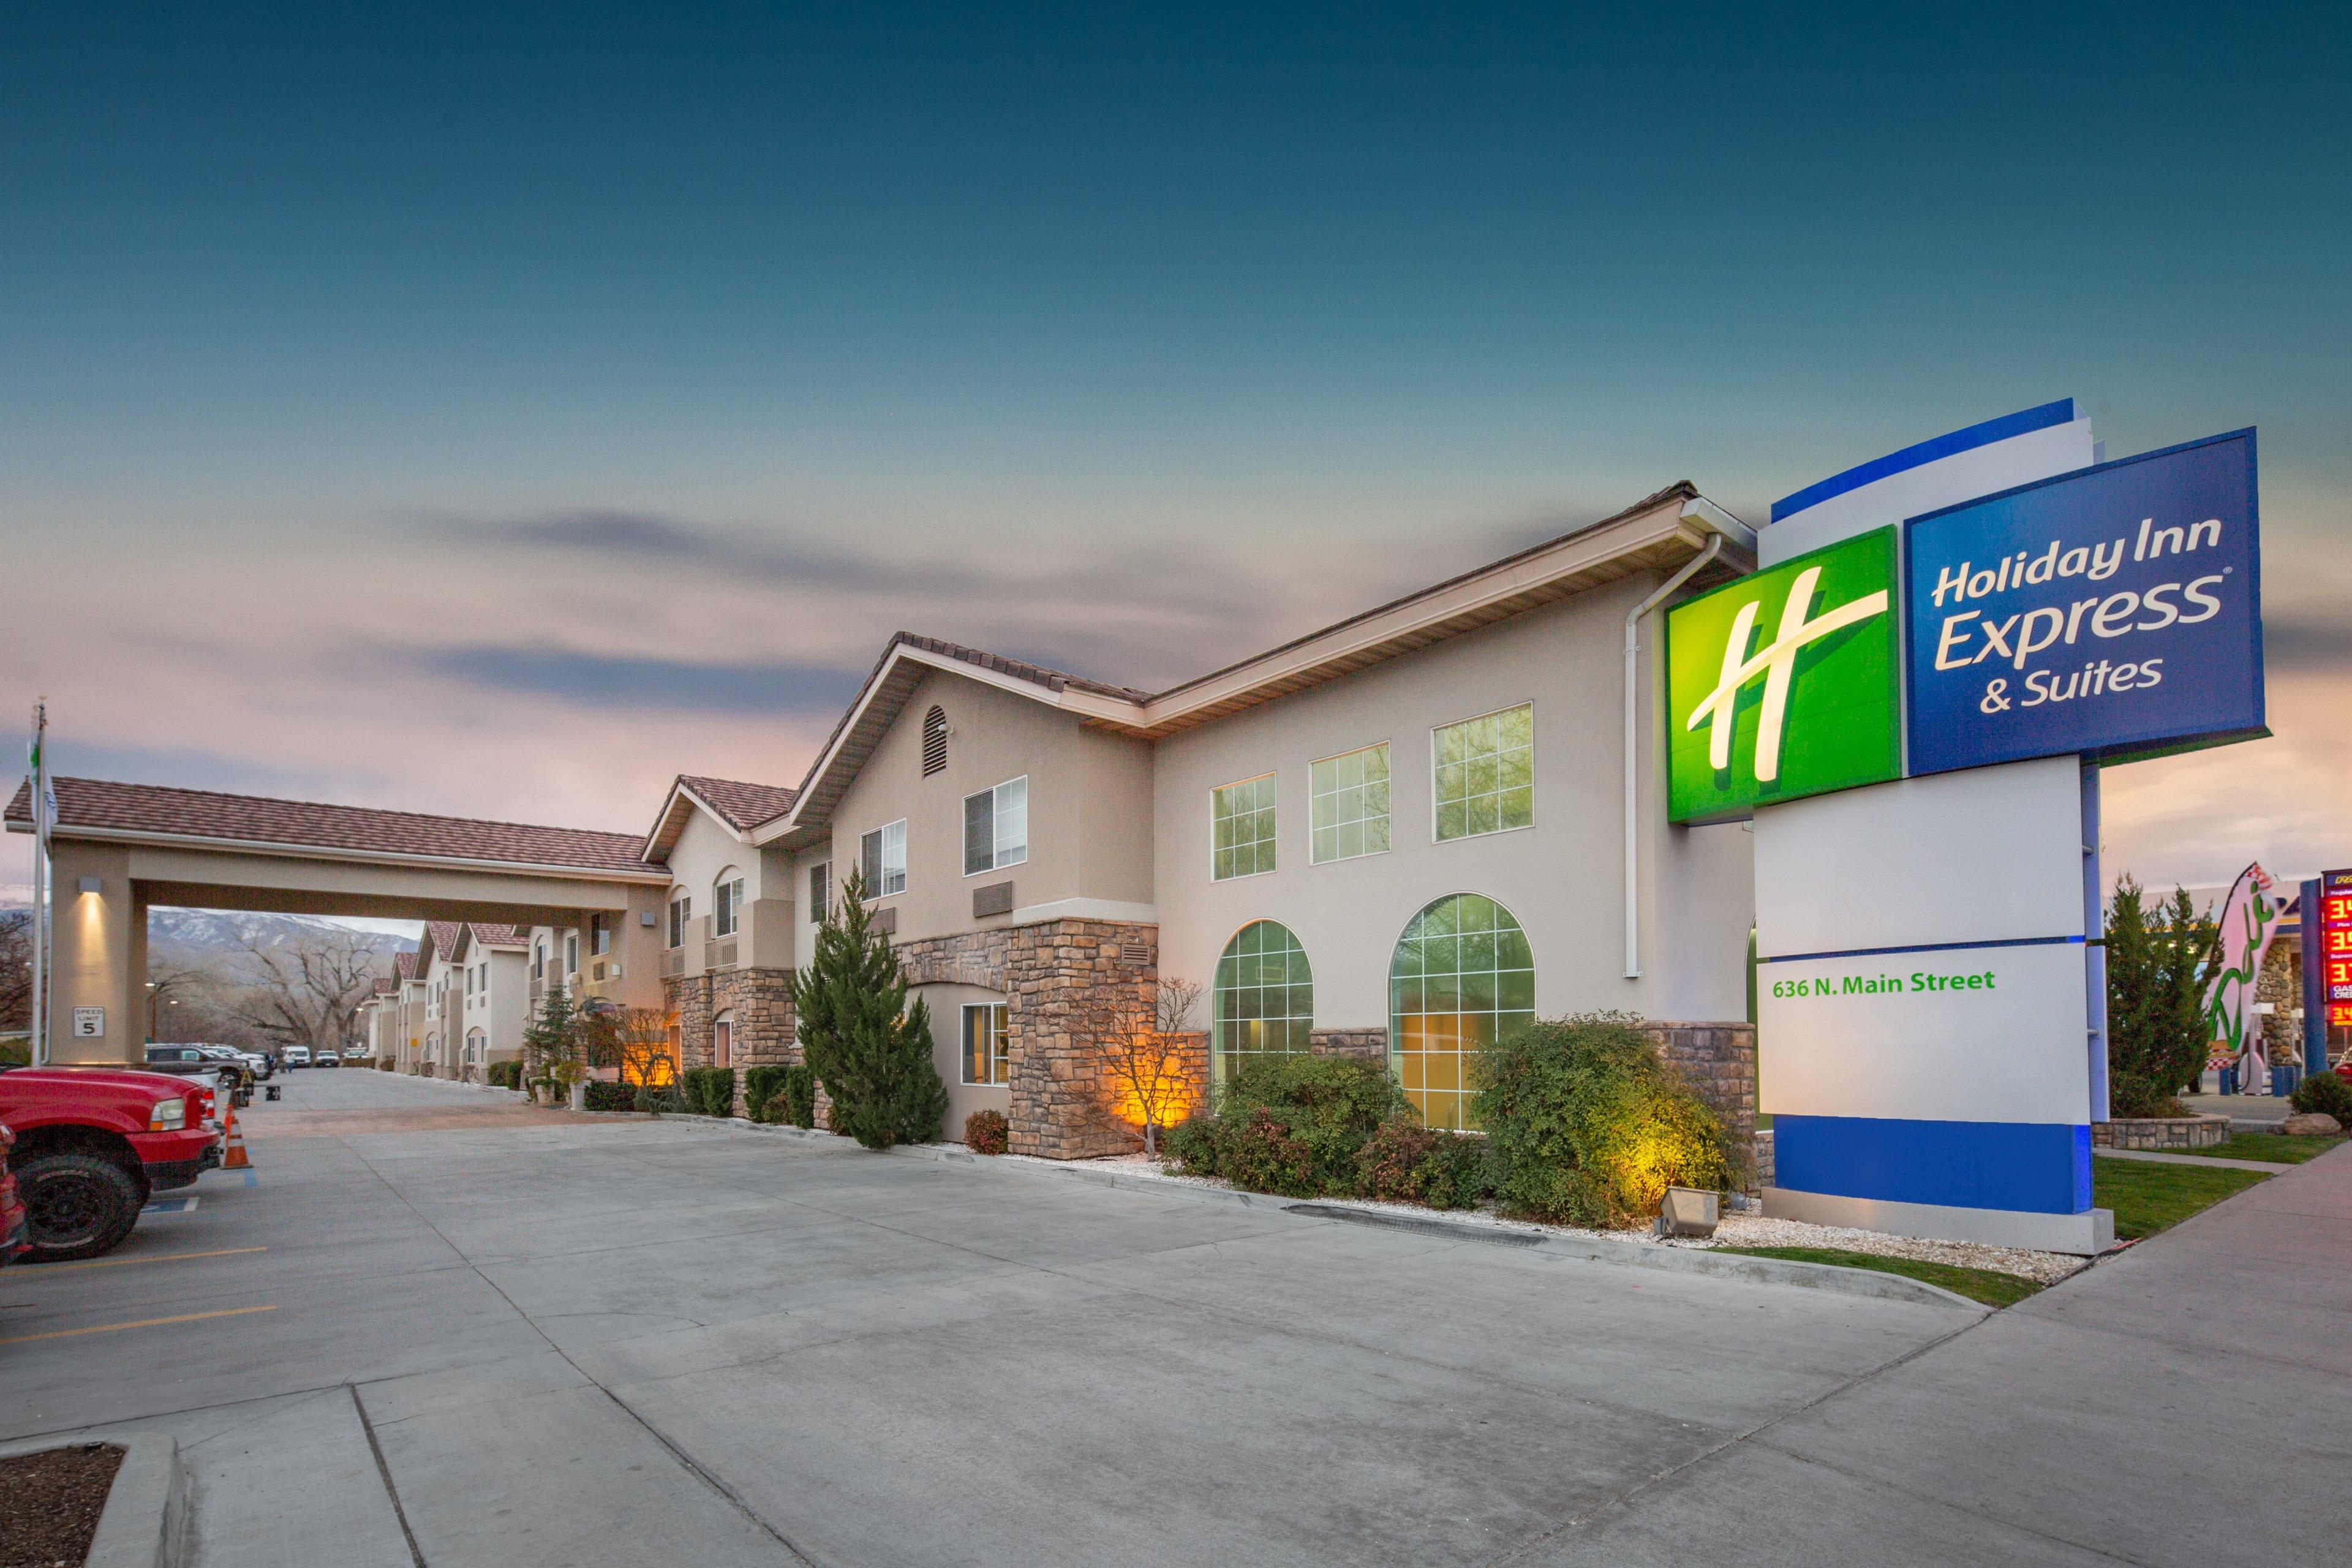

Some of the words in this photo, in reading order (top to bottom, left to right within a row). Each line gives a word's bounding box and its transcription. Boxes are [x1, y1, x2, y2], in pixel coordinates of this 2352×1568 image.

[1932, 539, 2125, 608] Holiday
[2134, 518, 2222, 561] Inn
[1935, 575, 2223, 671] Express
[1980, 679, 2011, 714] &
[2021, 659, 2163, 707] Suites
[1773, 979, 1810, 999] 636
[1815, 978, 1838, 997] N.
[1842, 974, 1903, 995] Main
[1911, 971, 1995, 992] Street
[83, 1023, 94, 1034] 5
